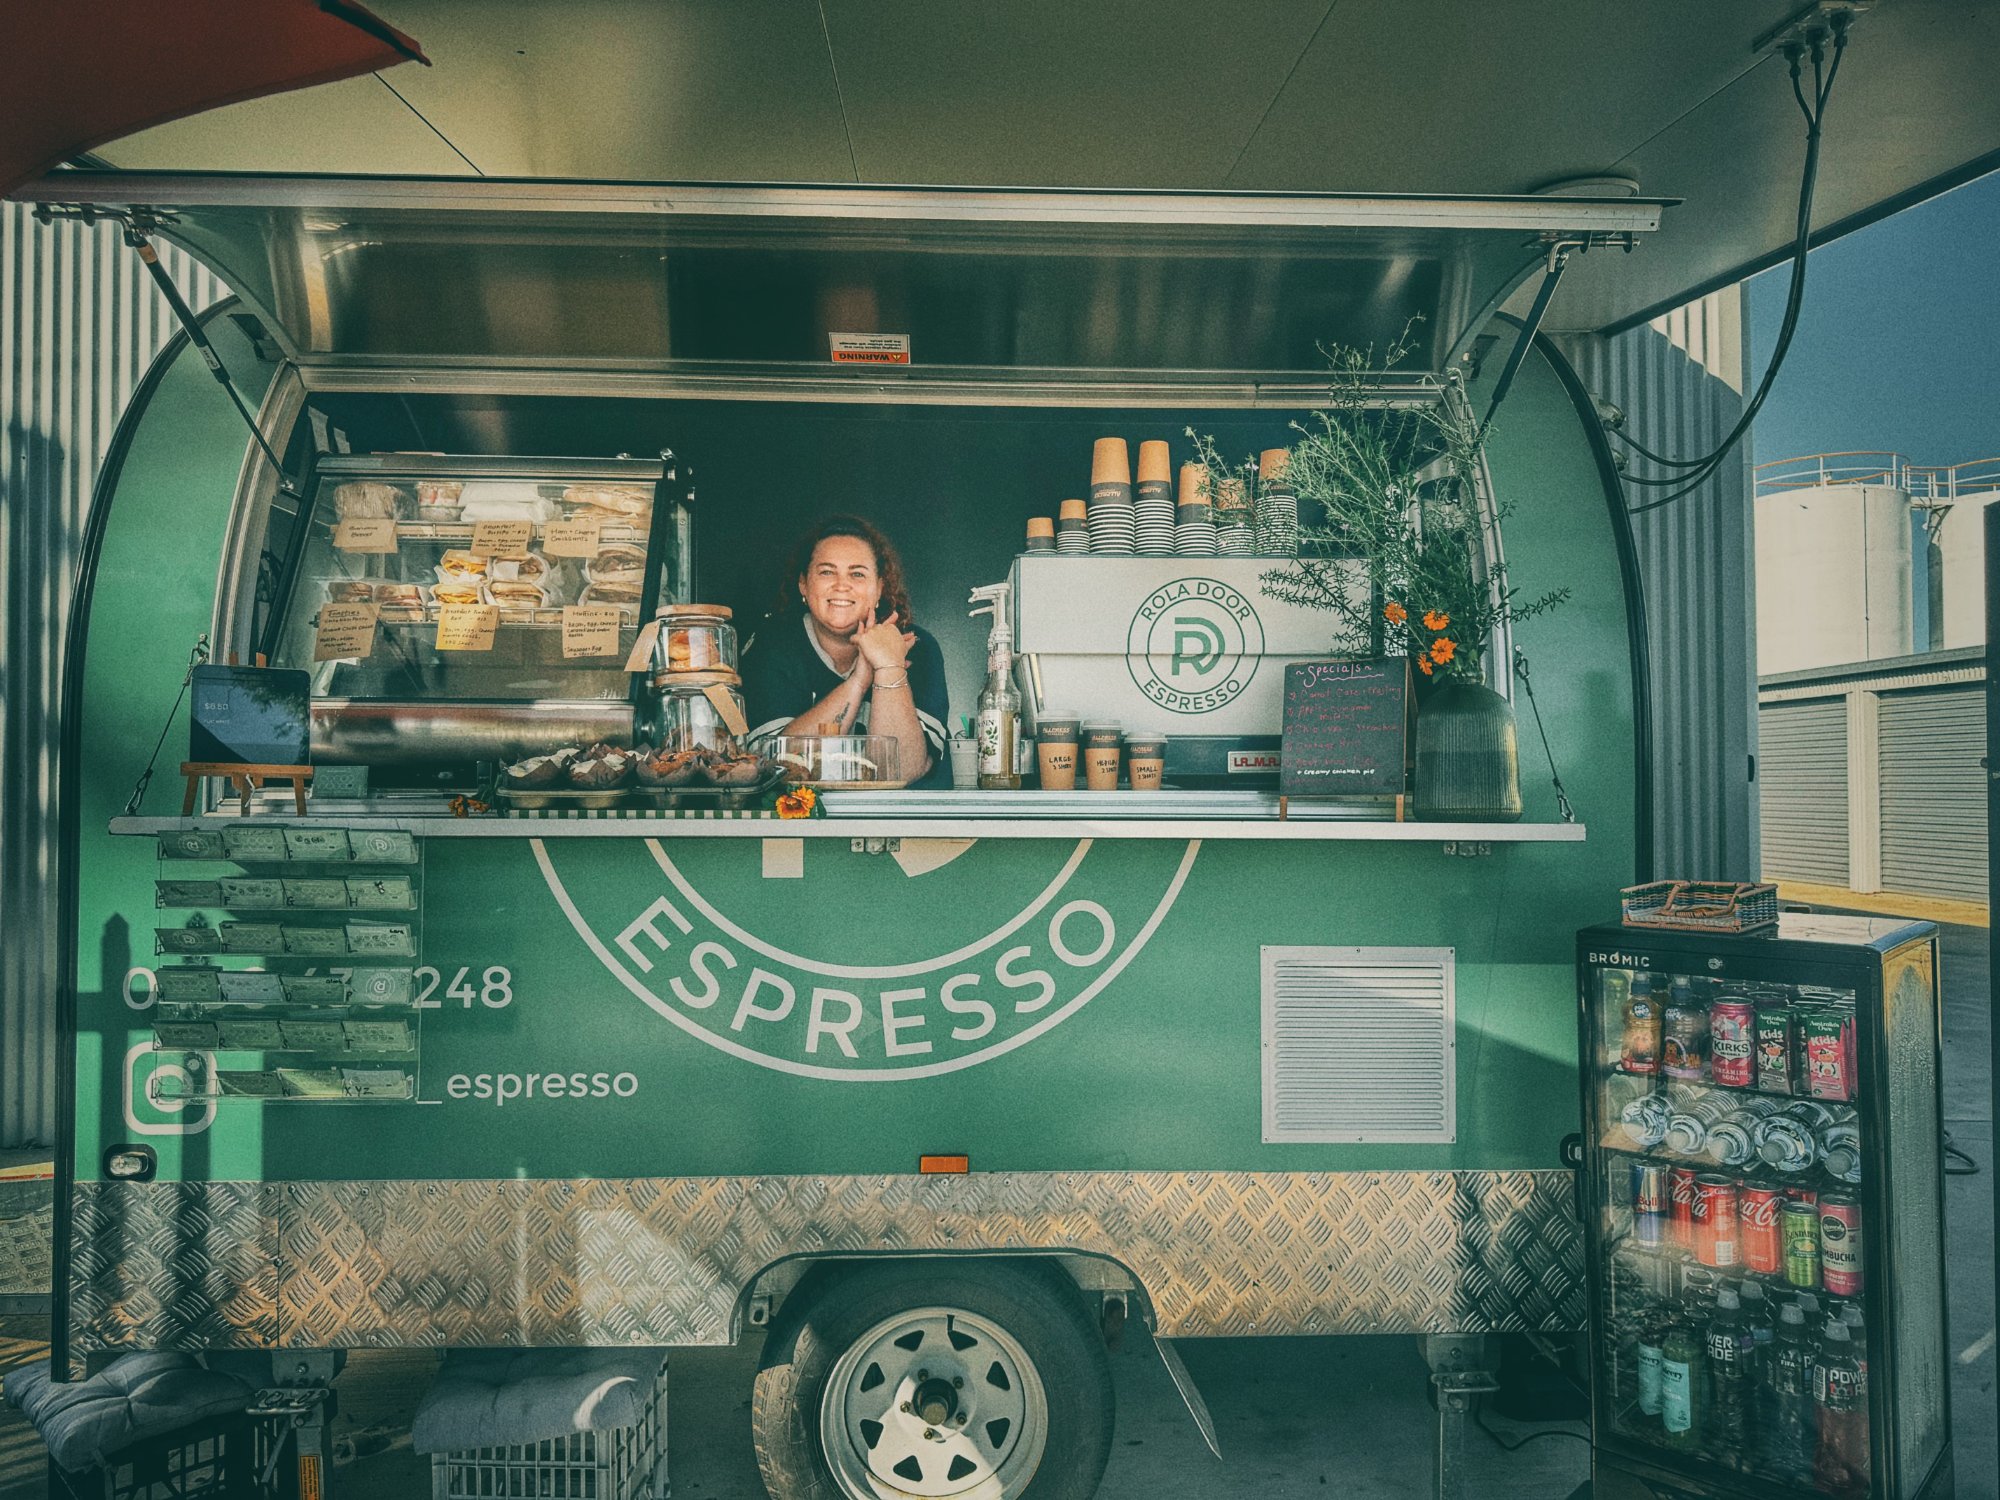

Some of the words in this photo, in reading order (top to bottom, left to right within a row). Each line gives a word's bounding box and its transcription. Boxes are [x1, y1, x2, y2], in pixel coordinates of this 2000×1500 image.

[839, 353, 890, 361] WARNING
[1141, 583, 1191, 621] ROLA
[1196, 582, 1251, 621] DOOR
[1143, 678, 1240, 710] ESPRESSO
[1136, 765, 1158, 773] SMALL
[1362, 768, 1375, 776] pie
[286, 896, 295, 907] G
[349, 897, 358, 907] H
[347, 944, 358, 954] L
[1589, 951, 1650, 967] BROMIC
[613, 895, 1115, 1058] ESPRESSO
[412, 965, 513, 1009] 248
[346, 990, 353, 1001] P
[1759, 1028, 1784, 1040] Kids
[219, 1038, 226, 1049] R
[282, 1038, 289, 1049] S
[345, 1039, 354, 1050] T
[1810, 1034, 1838, 1047] Kids
[1713, 1041, 1749, 1053] KIRKS
[1722, 1073, 1740, 1082] SODA
[1780, 1360, 1795, 1368] FIFA
